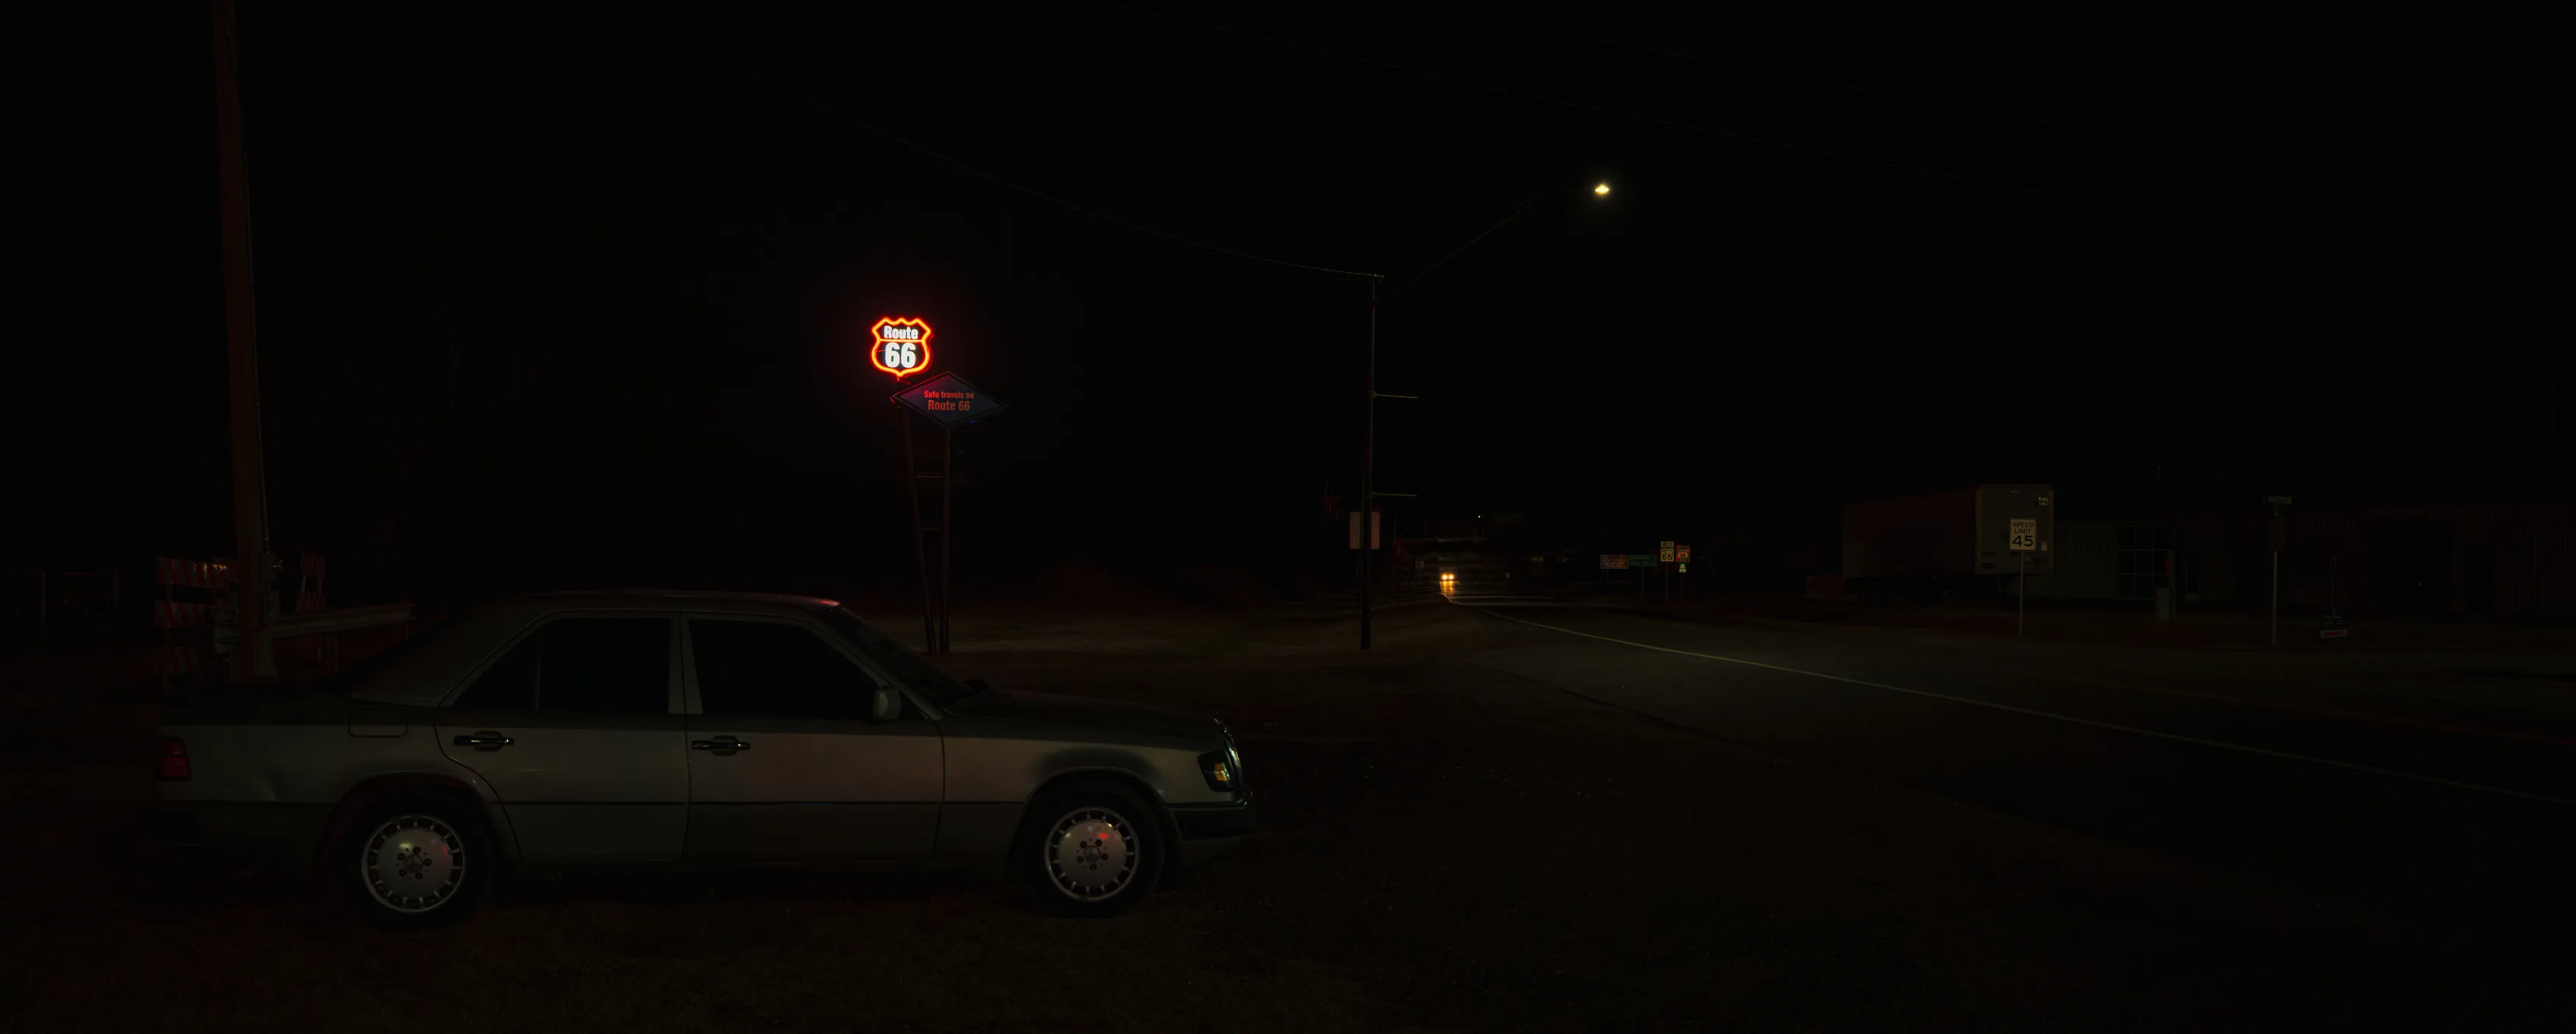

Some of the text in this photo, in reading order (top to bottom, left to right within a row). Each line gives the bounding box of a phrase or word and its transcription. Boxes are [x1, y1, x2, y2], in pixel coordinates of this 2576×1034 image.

[884, 325, 919, 339] Route
[885, 342, 916, 368] 66
[924, 390, 974, 400] Safe travels on
[927, 400, 970, 411] Route 66
[2011, 535, 2034, 547] 45
